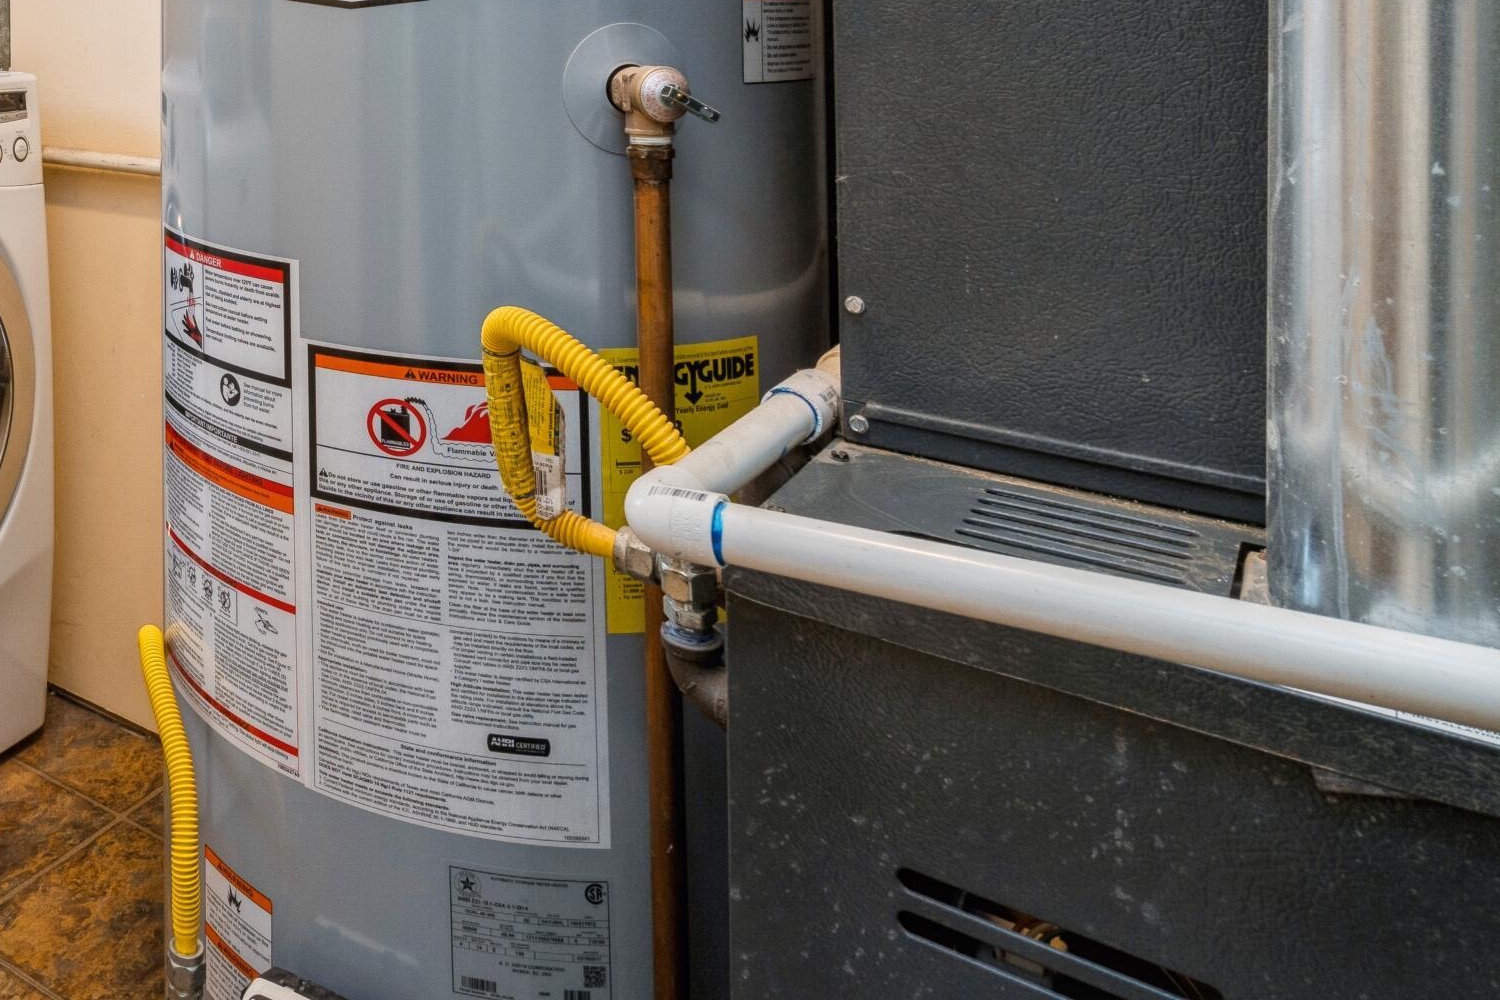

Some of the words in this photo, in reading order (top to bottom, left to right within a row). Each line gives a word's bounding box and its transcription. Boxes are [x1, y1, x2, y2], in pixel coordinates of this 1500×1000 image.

[196, 252, 222, 267] DANGER
[418, 370, 478, 385] WARNING
[675, 405, 694, 414] Yearly
[696, 403, 715, 413] Energy
[447, 447, 486, 457] Flammable
[396, 463, 410, 471] FIRE
[426, 467, 462, 476] EXPLOSION
[464, 471, 491, 479] HAZARD
[403, 475, 420, 483] result
[382, 482, 406, 492] gasoline
[434, 491, 465, 499] flammable
[433, 505, 462, 514] appliance
[455, 500, 481, 508] gasoline
[353, 514, 372, 523] Protect
[375, 518, 395, 528] against
[398, 522, 412, 530] leaks
